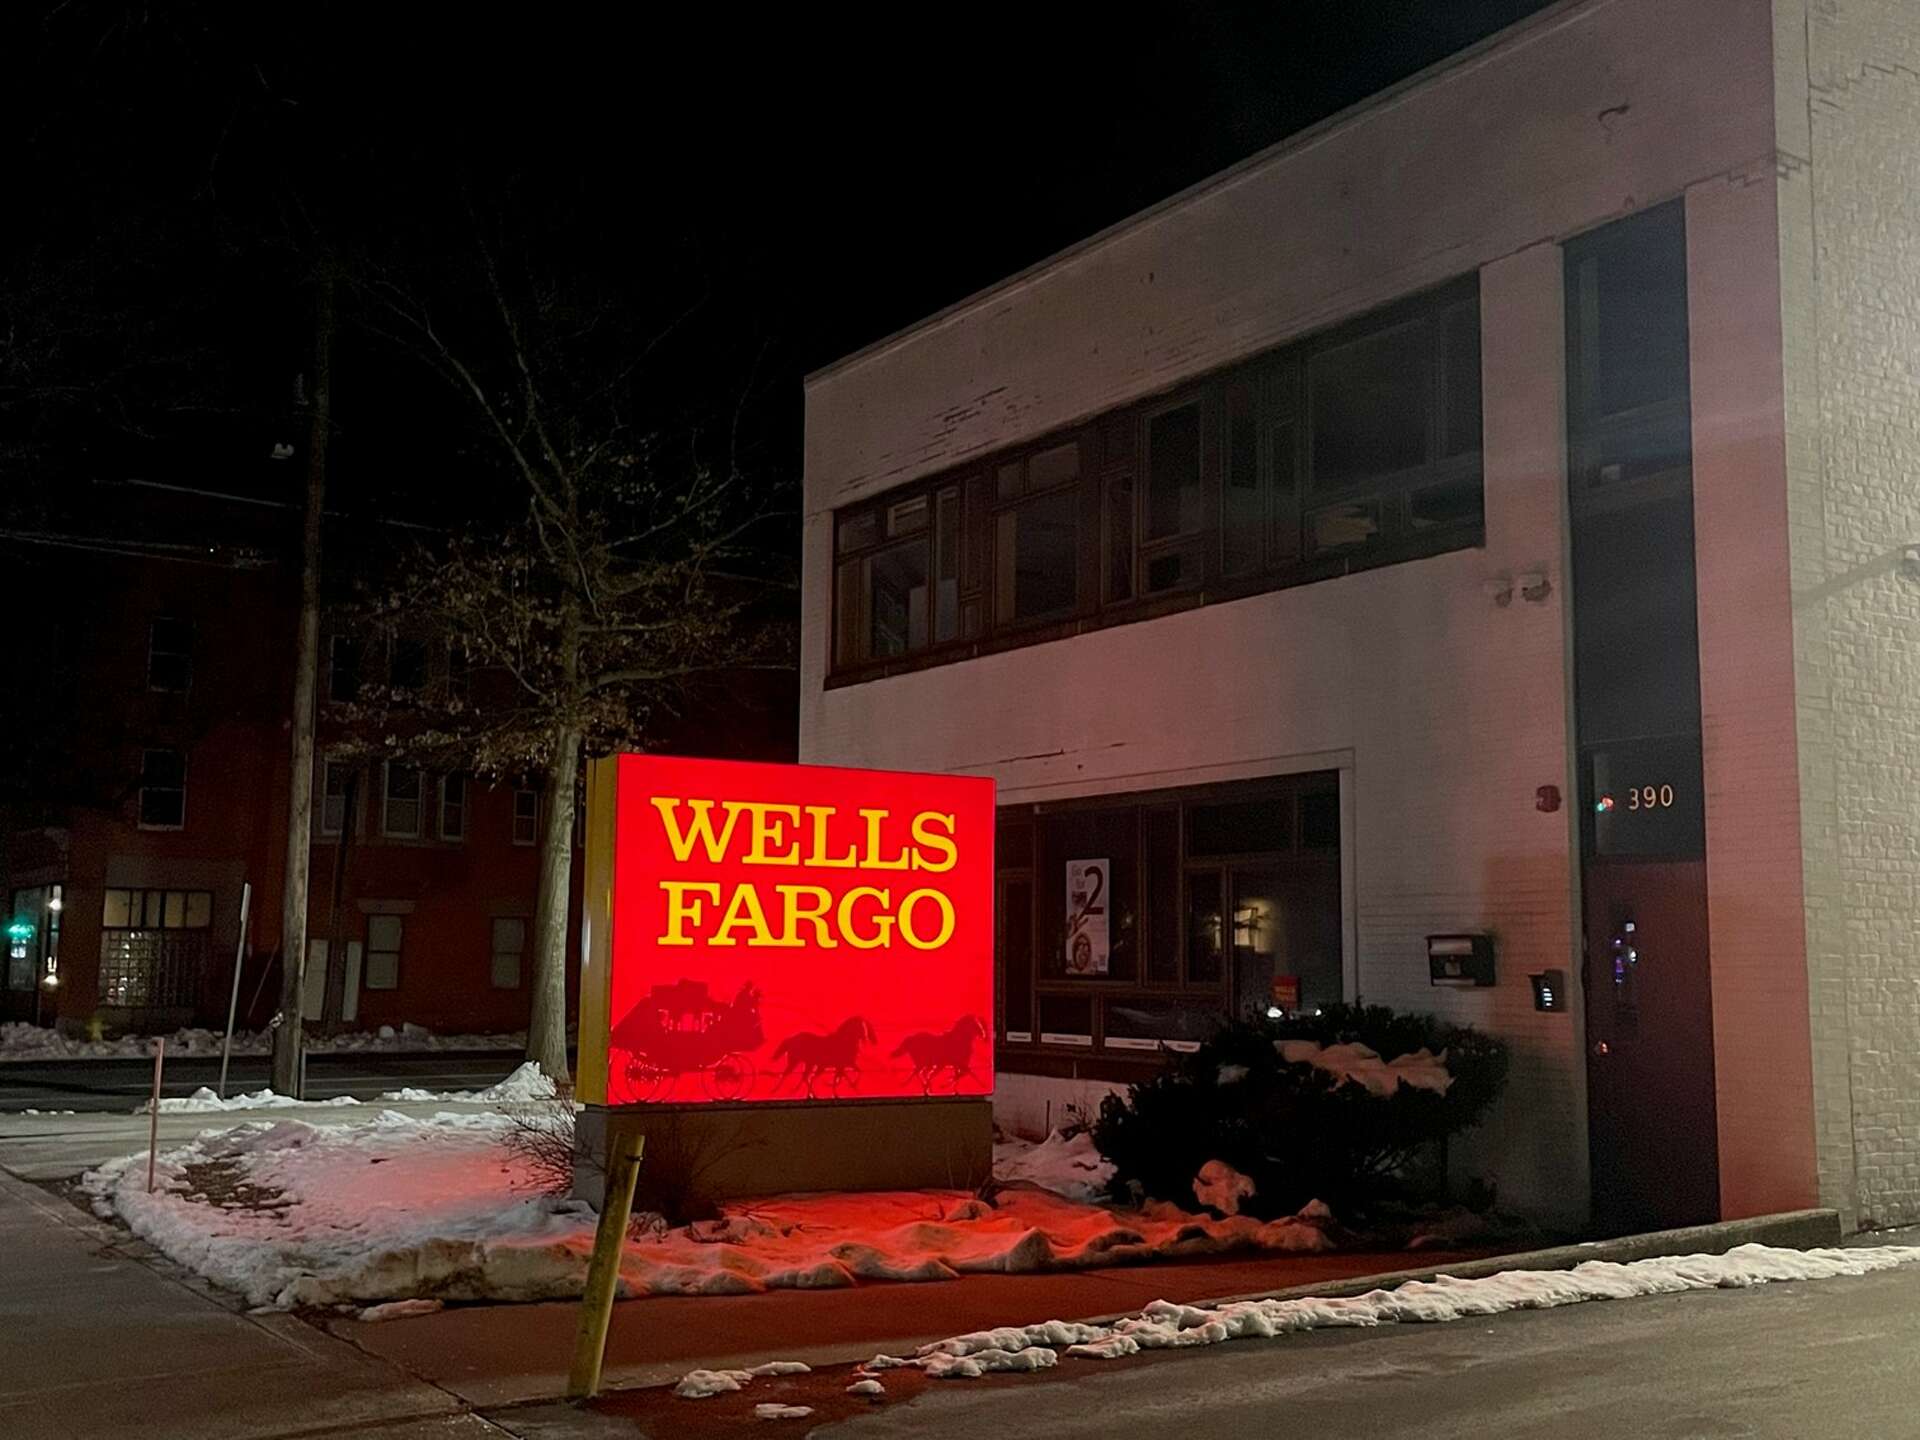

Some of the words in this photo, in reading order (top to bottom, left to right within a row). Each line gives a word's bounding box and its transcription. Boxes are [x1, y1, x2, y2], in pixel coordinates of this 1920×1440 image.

[1628, 785, 1674, 810] 390
[651, 797, 958, 873] WELLS
[657, 881, 956, 950] FARGO
